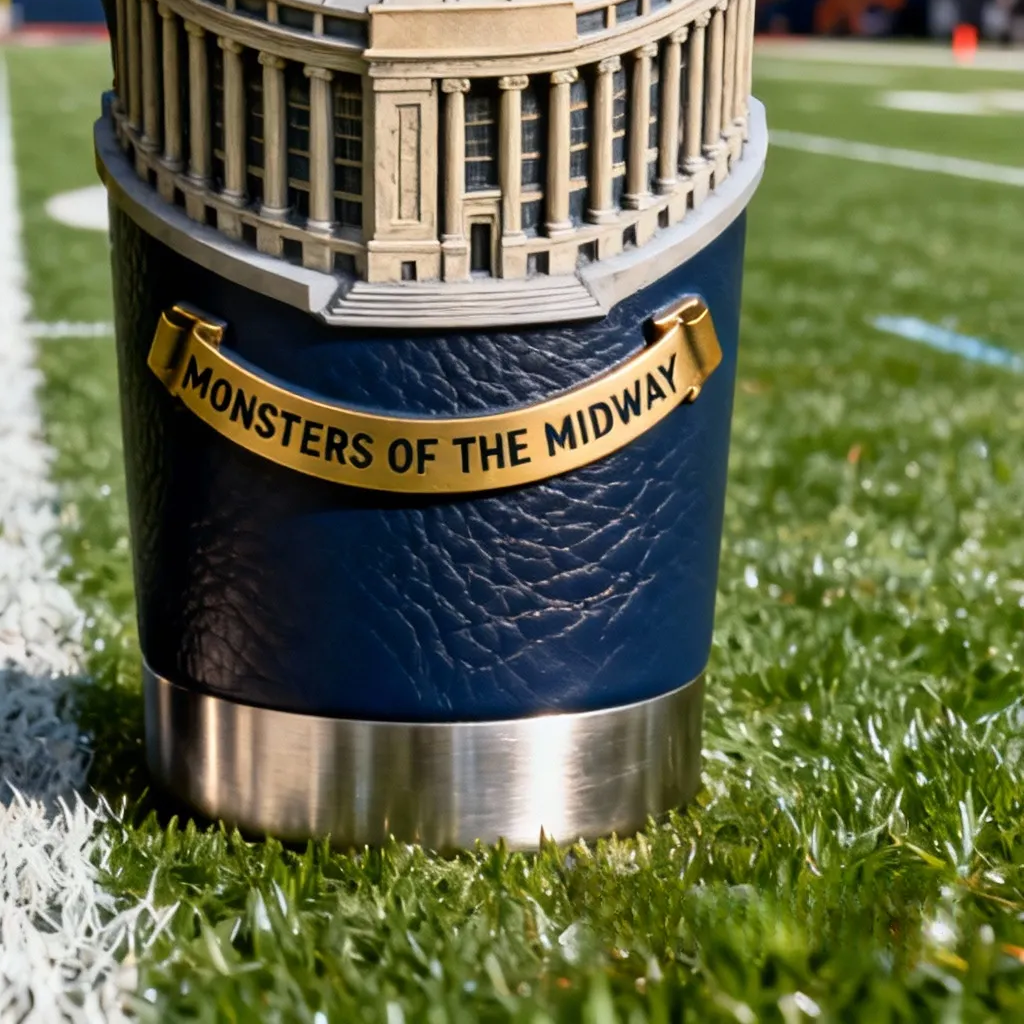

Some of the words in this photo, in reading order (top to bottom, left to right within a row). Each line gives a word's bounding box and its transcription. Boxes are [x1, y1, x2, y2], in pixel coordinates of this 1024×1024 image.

[182, 354, 374, 470] MONSTERS
[387, 437, 437, 475] OF
[452, 429, 529, 473] THE
[543, 354, 680, 457] MIDWAY
